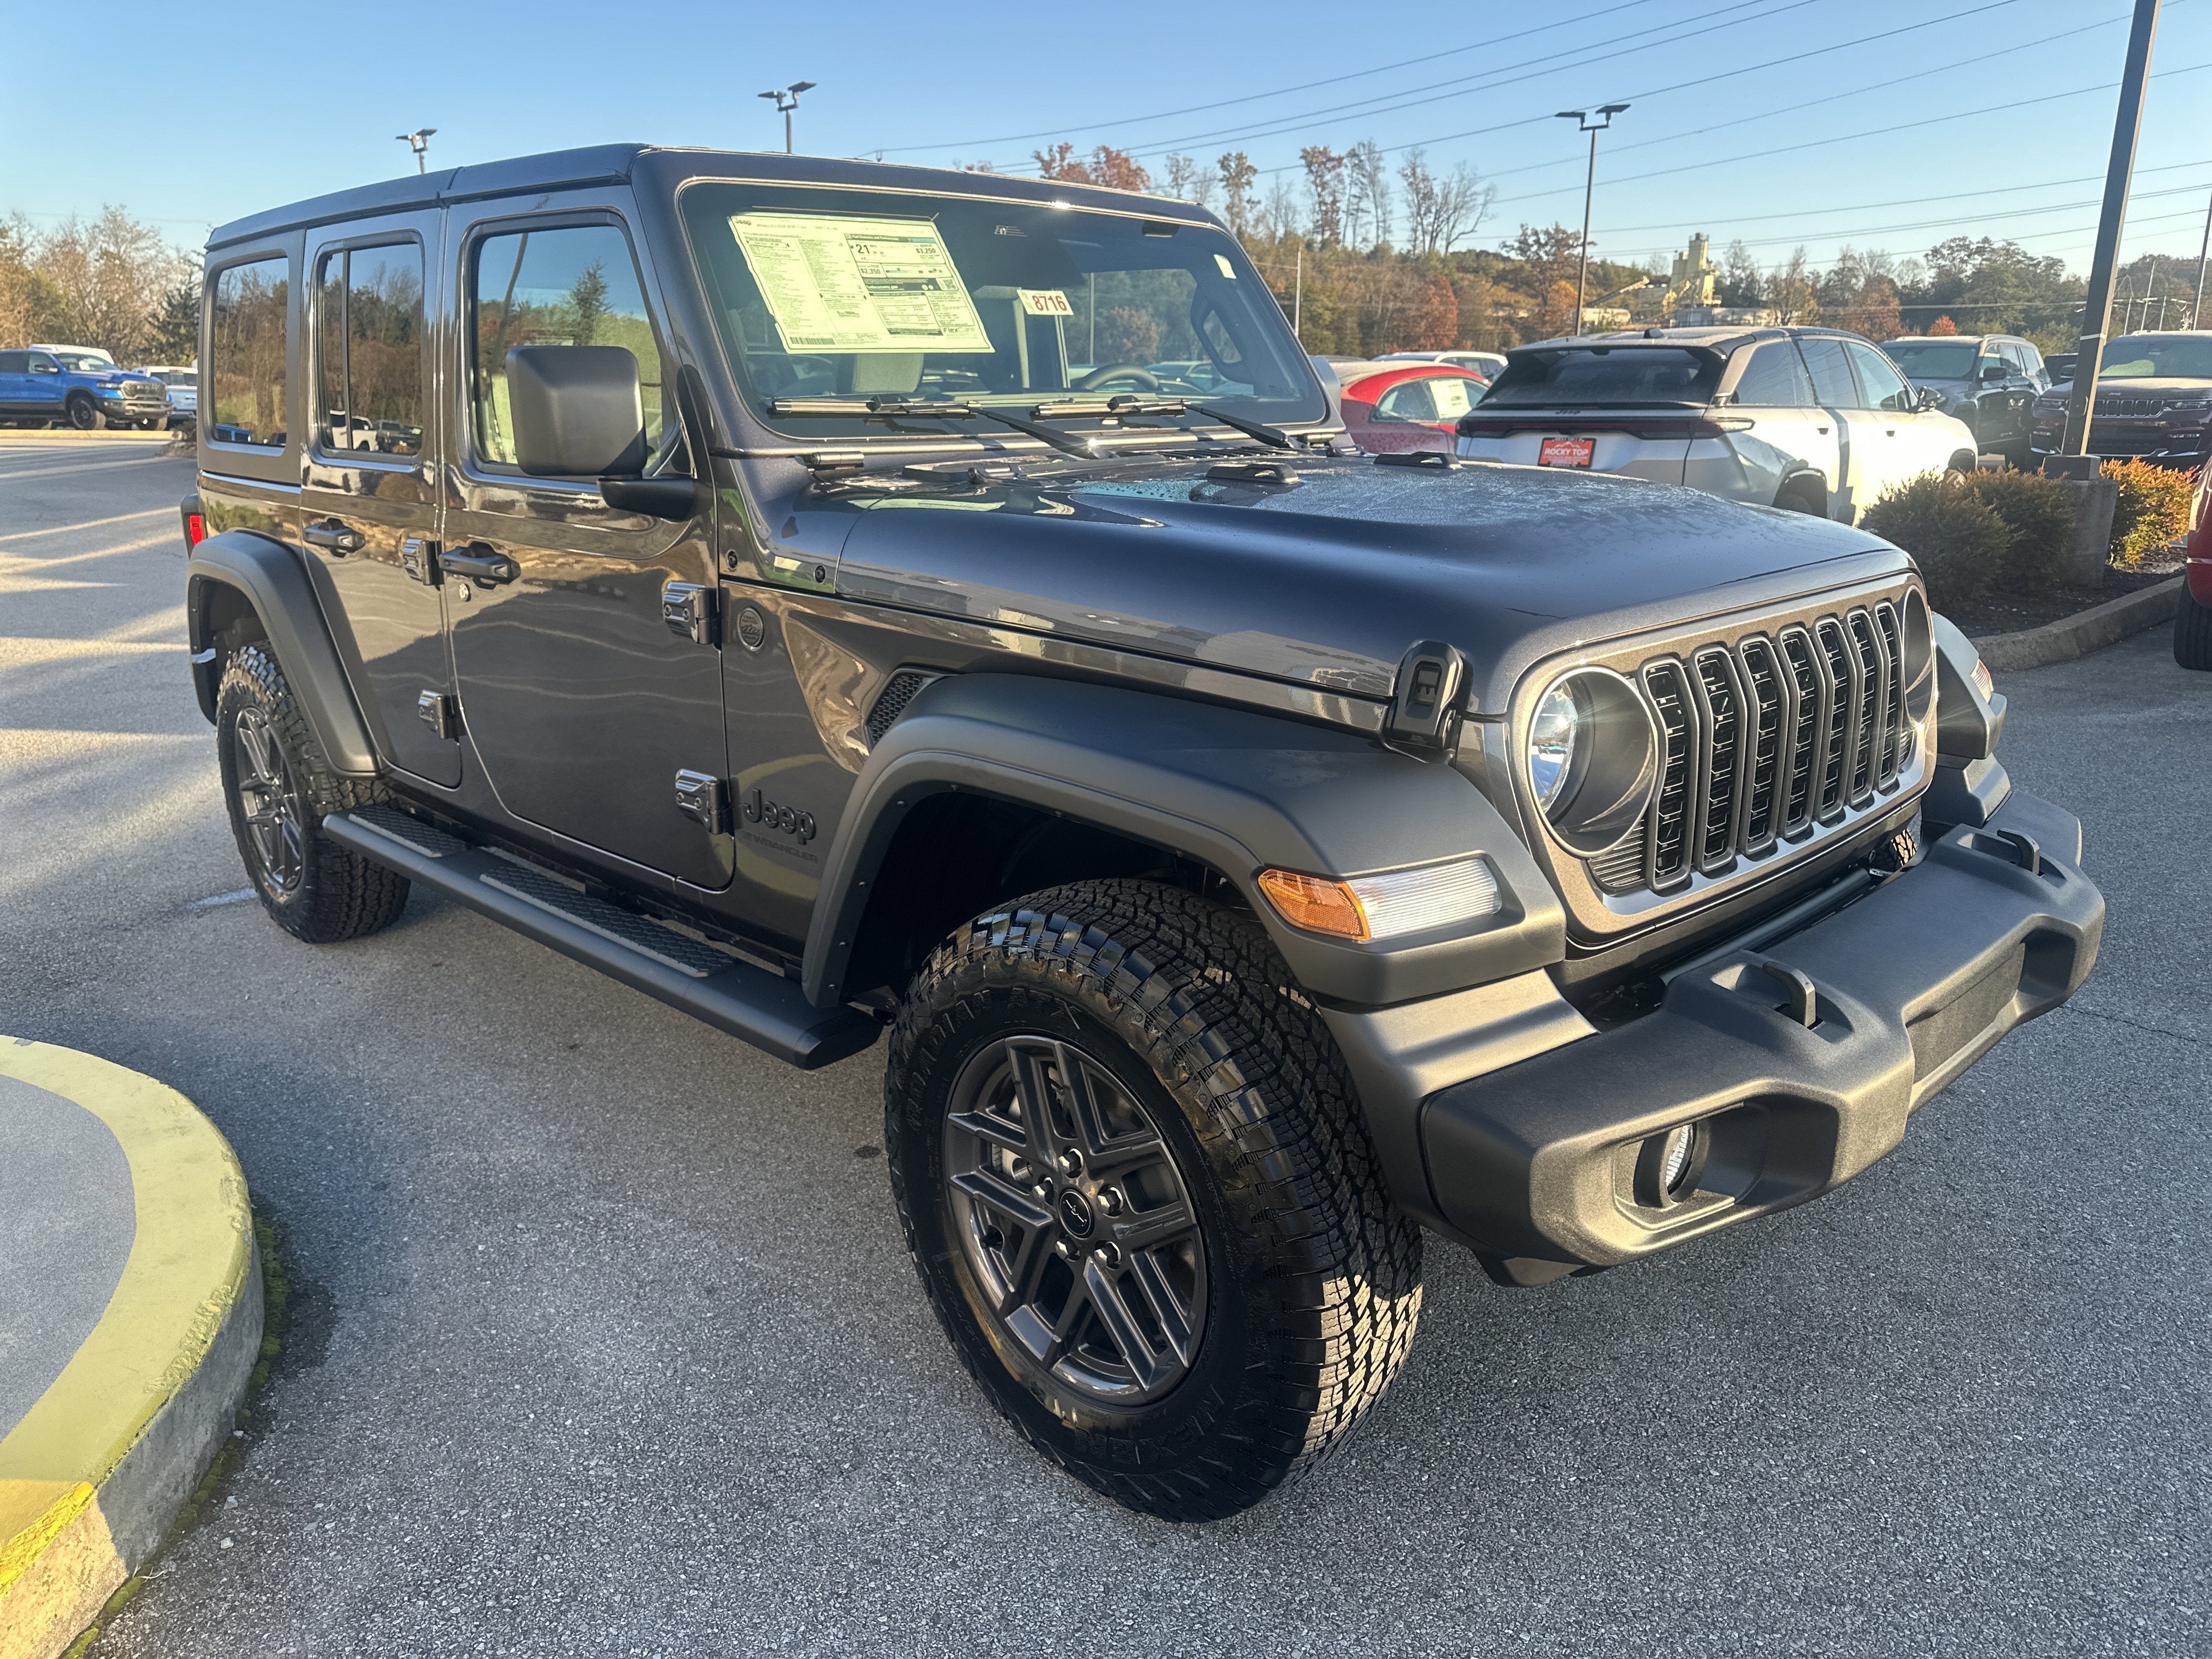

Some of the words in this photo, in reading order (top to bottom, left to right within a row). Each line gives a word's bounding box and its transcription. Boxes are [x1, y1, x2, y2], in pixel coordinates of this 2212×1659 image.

[856, 244, 870, 254] 21
[1032, 295, 1067, 311] 8716
[1544, 448, 1571, 456] ROCKY
[742, 787, 816, 845] Jeep
[752, 833, 819, 864] WRANGLER
